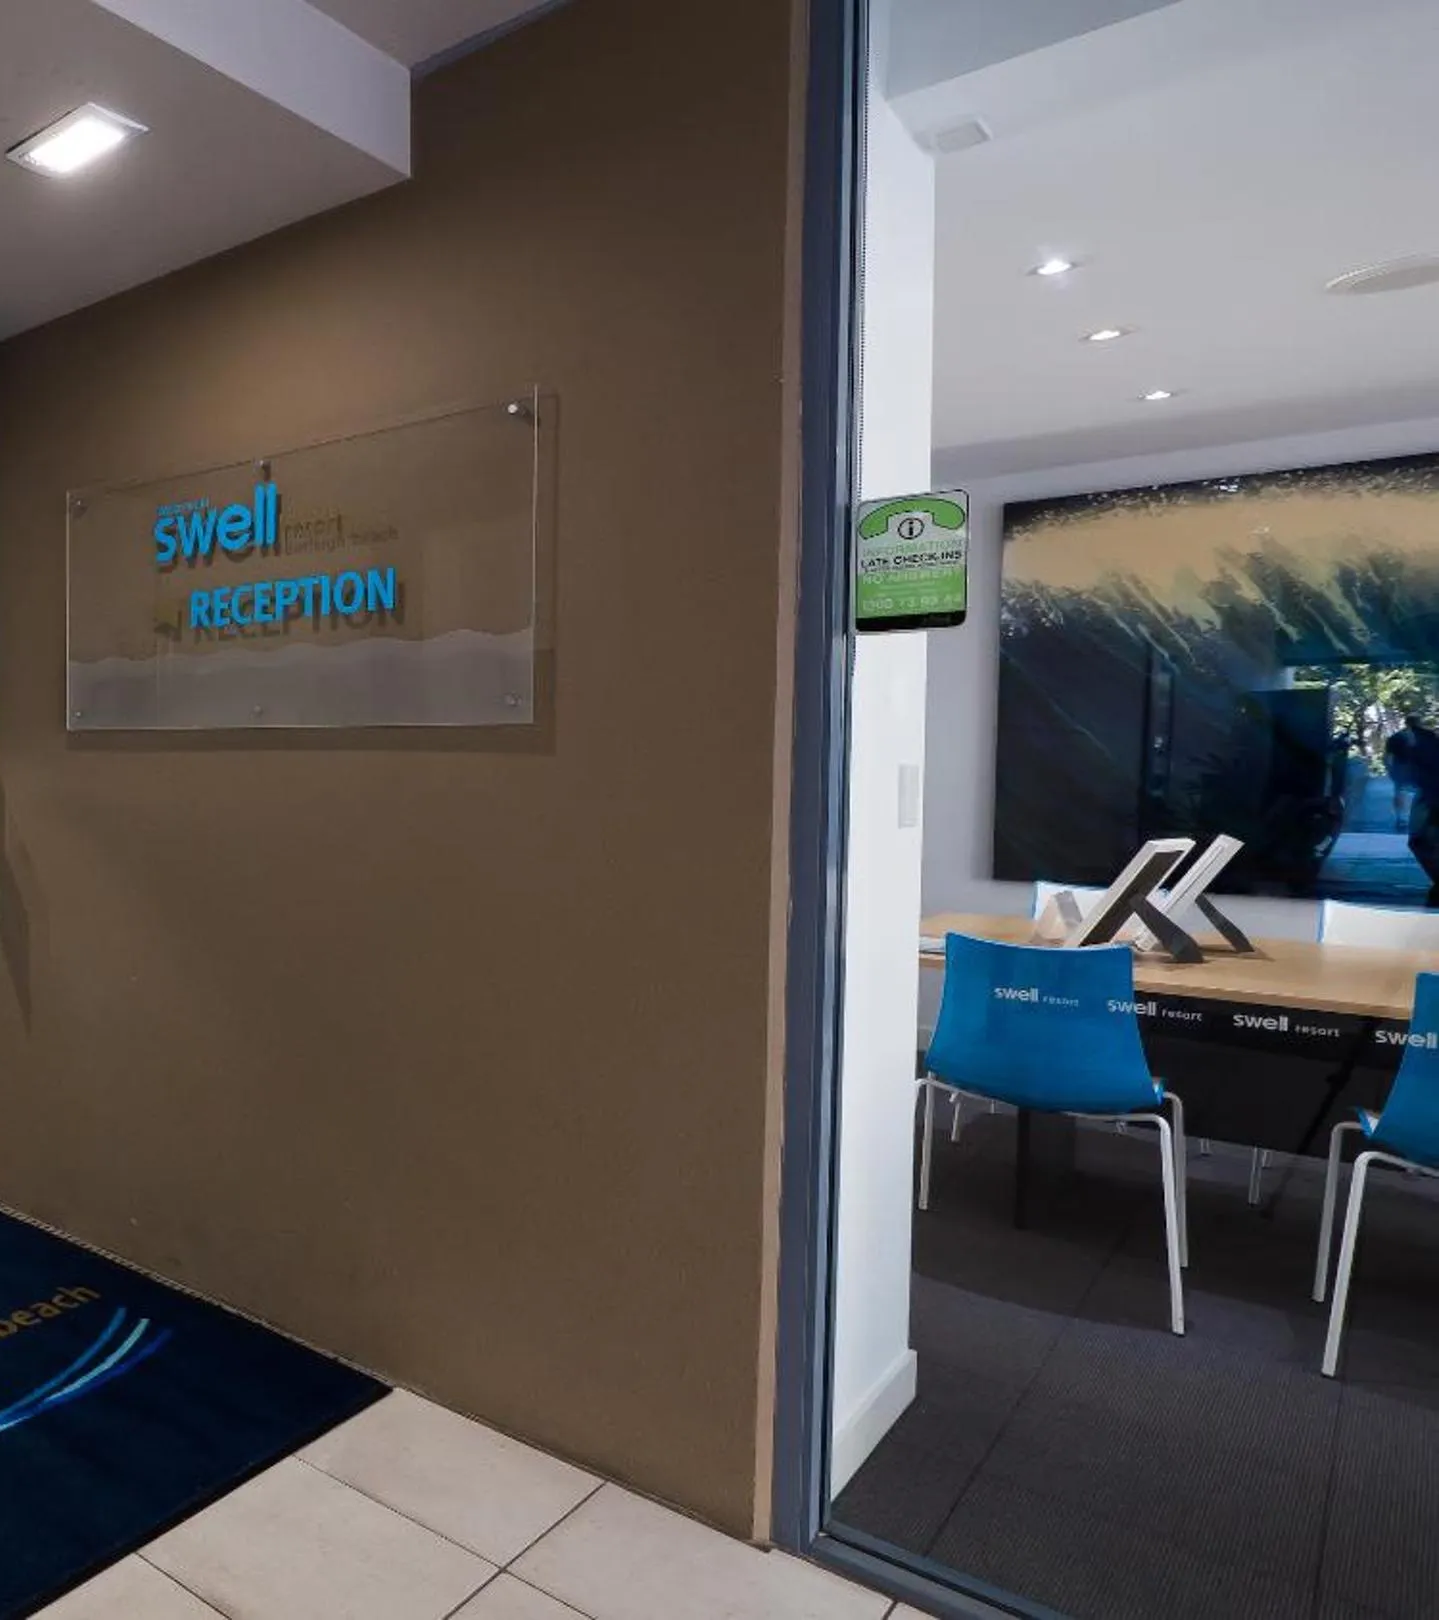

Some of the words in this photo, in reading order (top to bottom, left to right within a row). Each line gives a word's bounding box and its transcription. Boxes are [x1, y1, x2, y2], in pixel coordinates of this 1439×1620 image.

[154, 481, 278, 564] swell
[189, 566, 396, 629] RECEPTION
[994, 987, 1039, 1003] swell
[1108, 999, 1157, 1016] swell
[1233, 1014, 1289, 1032] swell
[1375, 1030, 1438, 1049] swell
